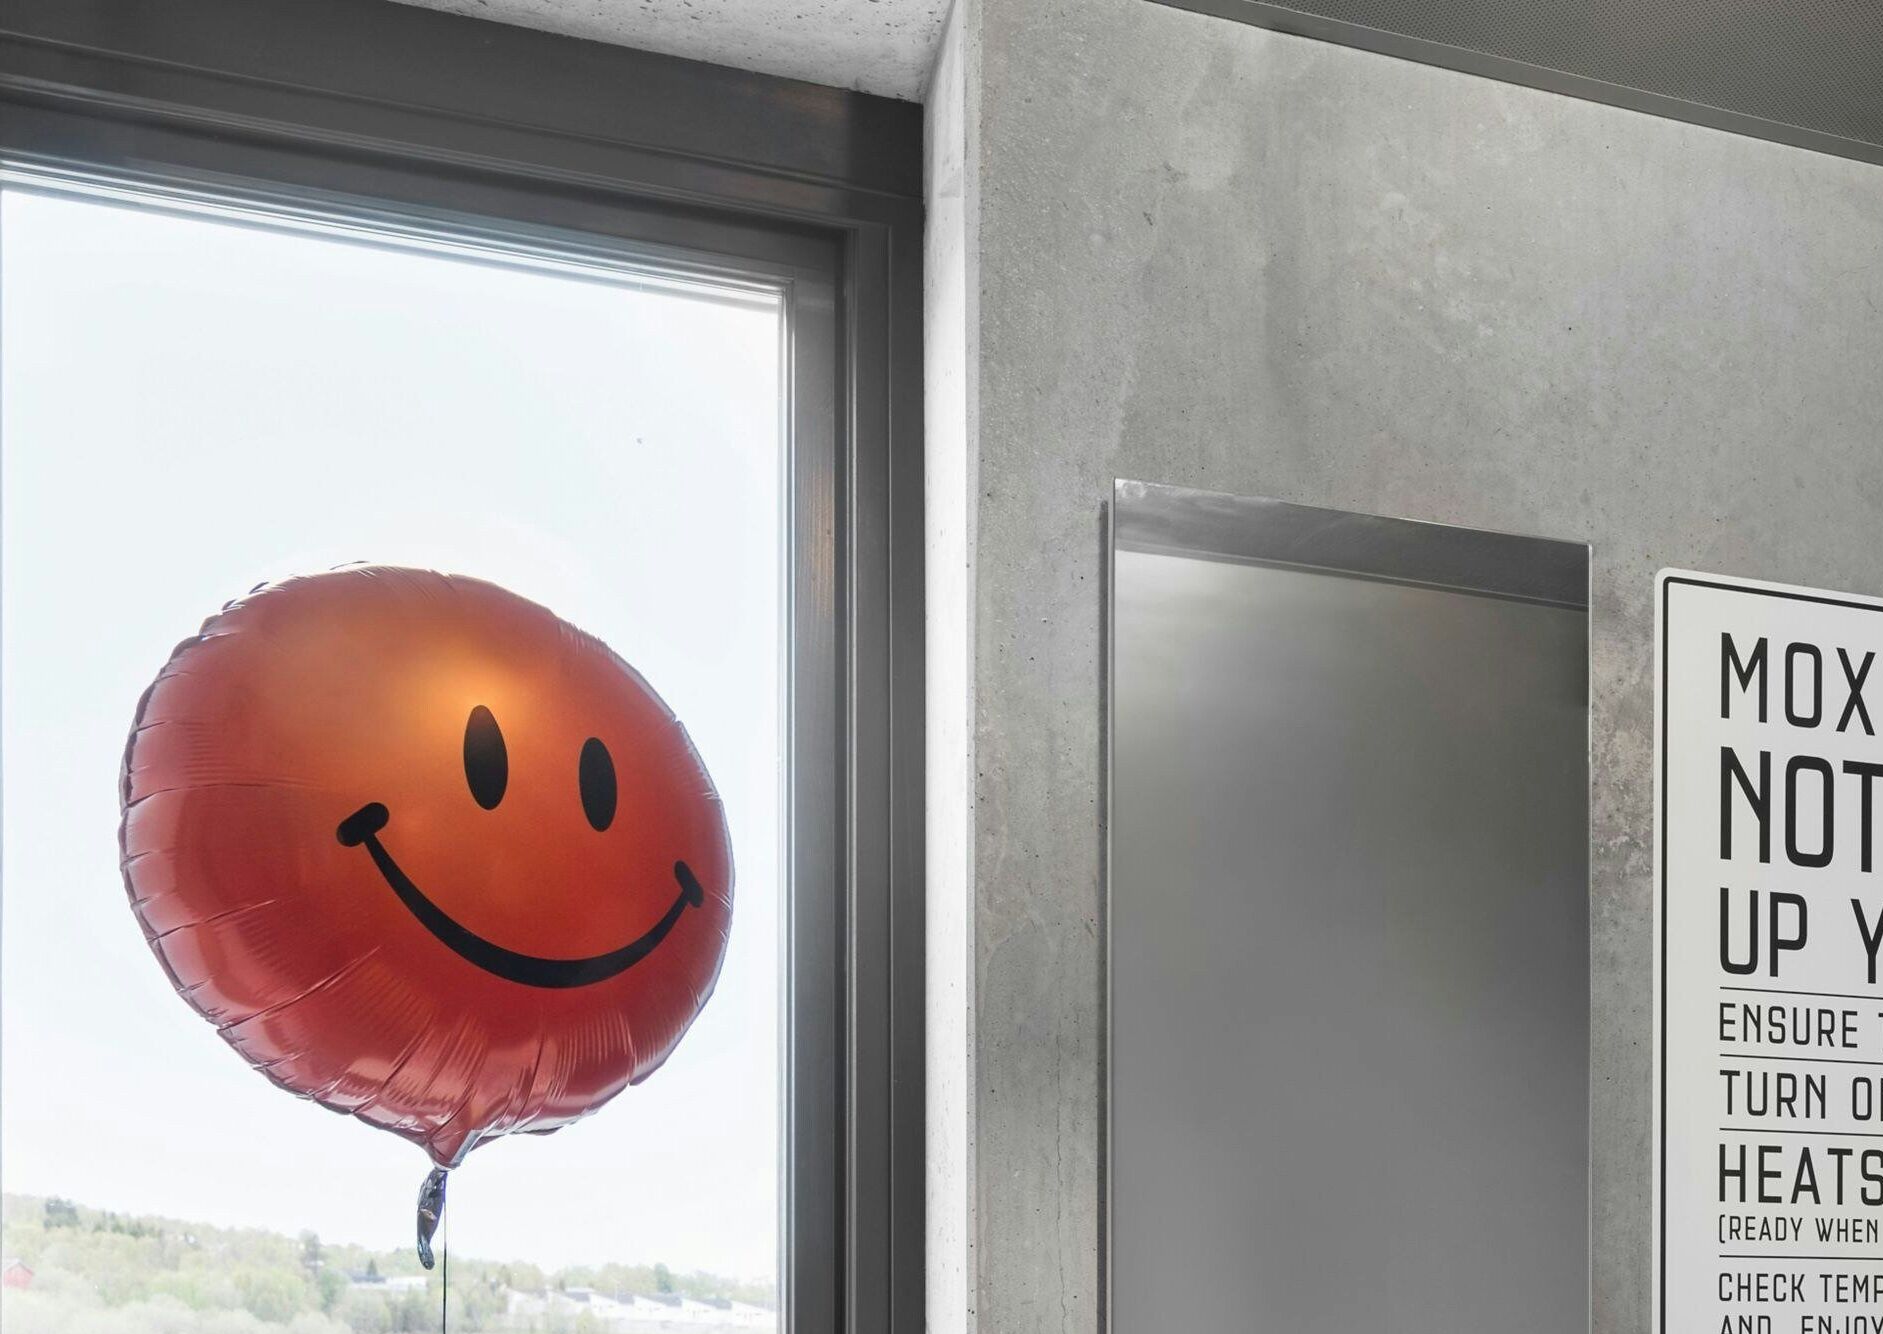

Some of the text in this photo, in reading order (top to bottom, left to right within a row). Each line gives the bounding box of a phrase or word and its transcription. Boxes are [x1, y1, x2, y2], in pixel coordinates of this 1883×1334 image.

[1720, 888, 1807, 977] UP
[1720, 1003, 1857, 1048] ENSURE
[1720, 1070, 1825, 1119] TURN
[1816, 1218, 1877, 1242] WHEN
[1719, 1273, 1804, 1302] CHECK
